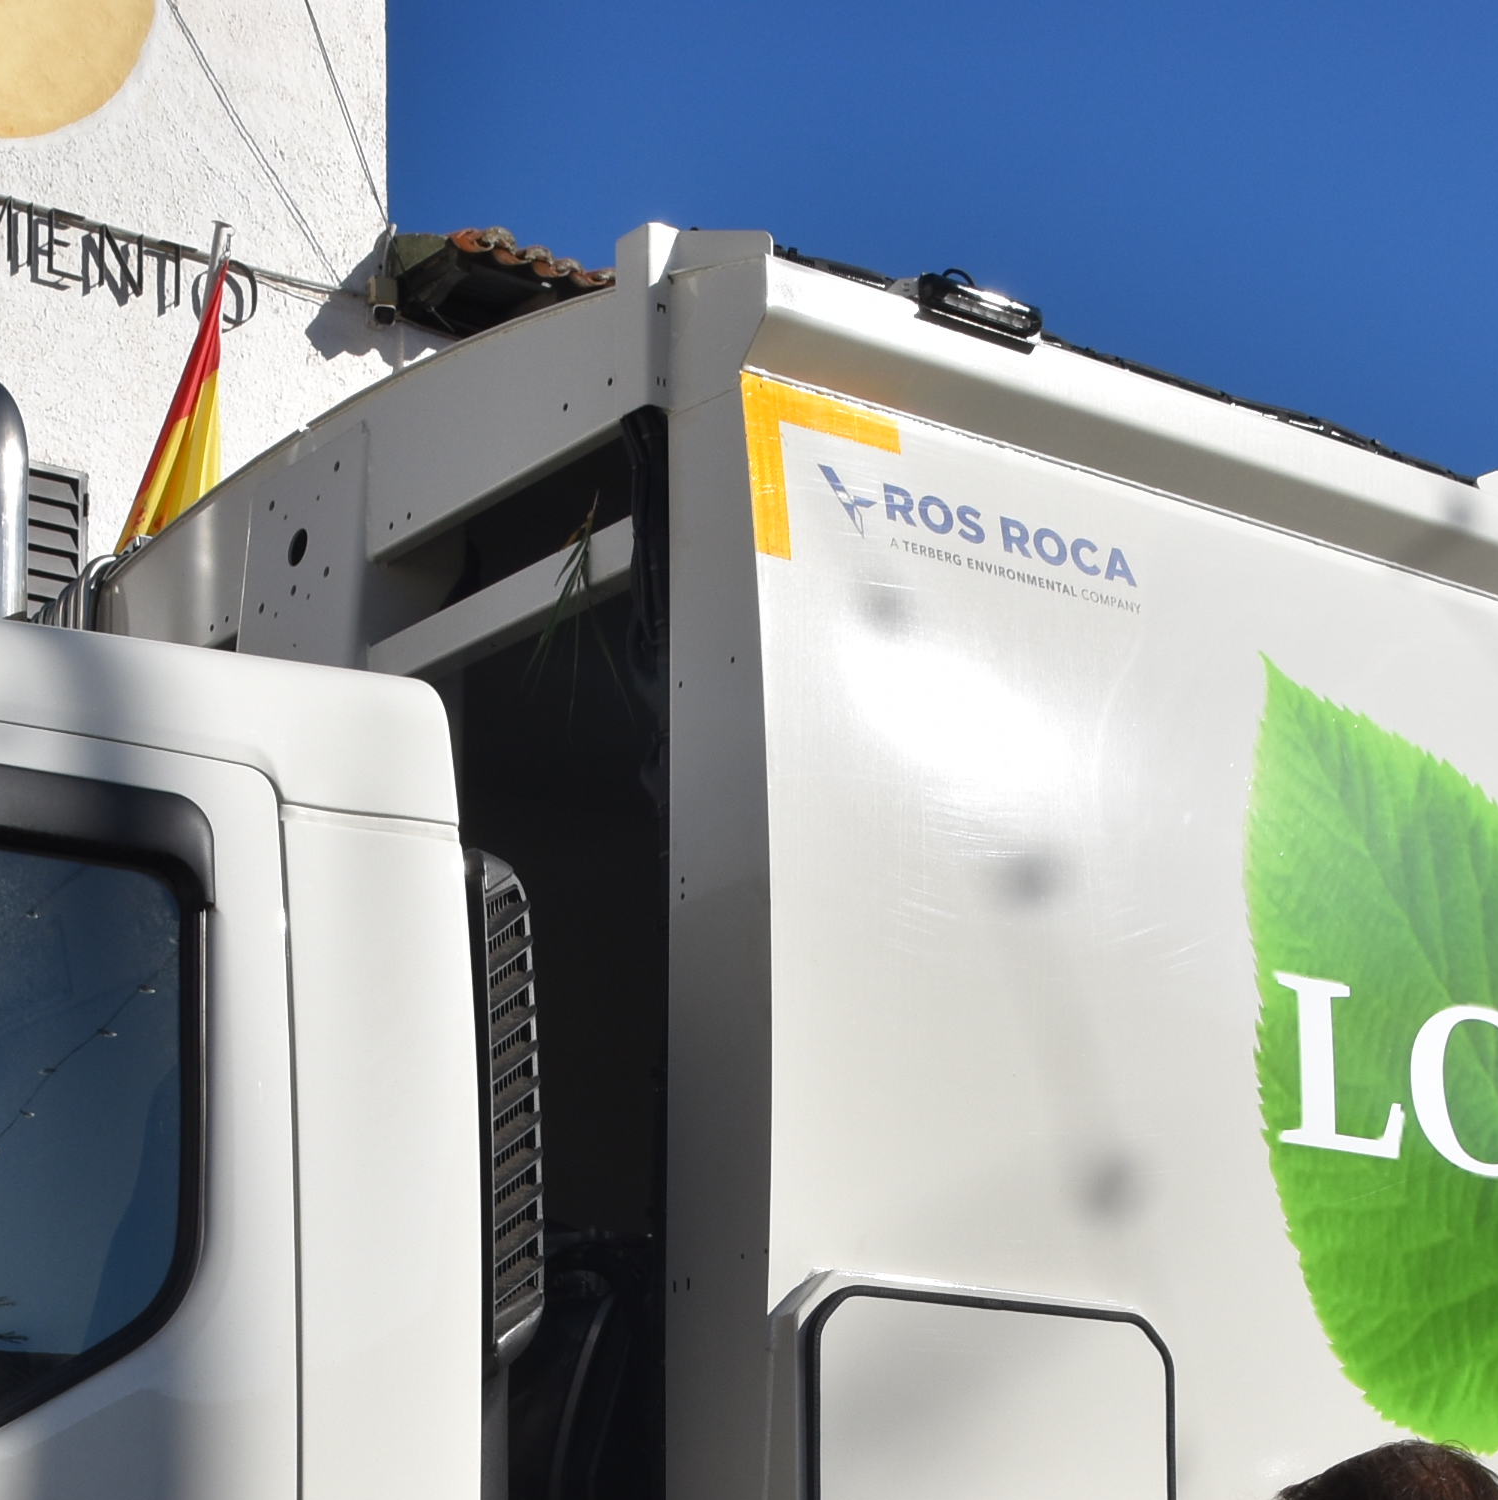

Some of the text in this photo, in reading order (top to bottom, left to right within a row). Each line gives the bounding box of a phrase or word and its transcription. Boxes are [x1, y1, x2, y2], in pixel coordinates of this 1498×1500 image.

[883, 483, 1137, 587] ROS ROCA
[890, 537, 1141, 614] A TERBERG ENVIRONMENTAL COMPANY
